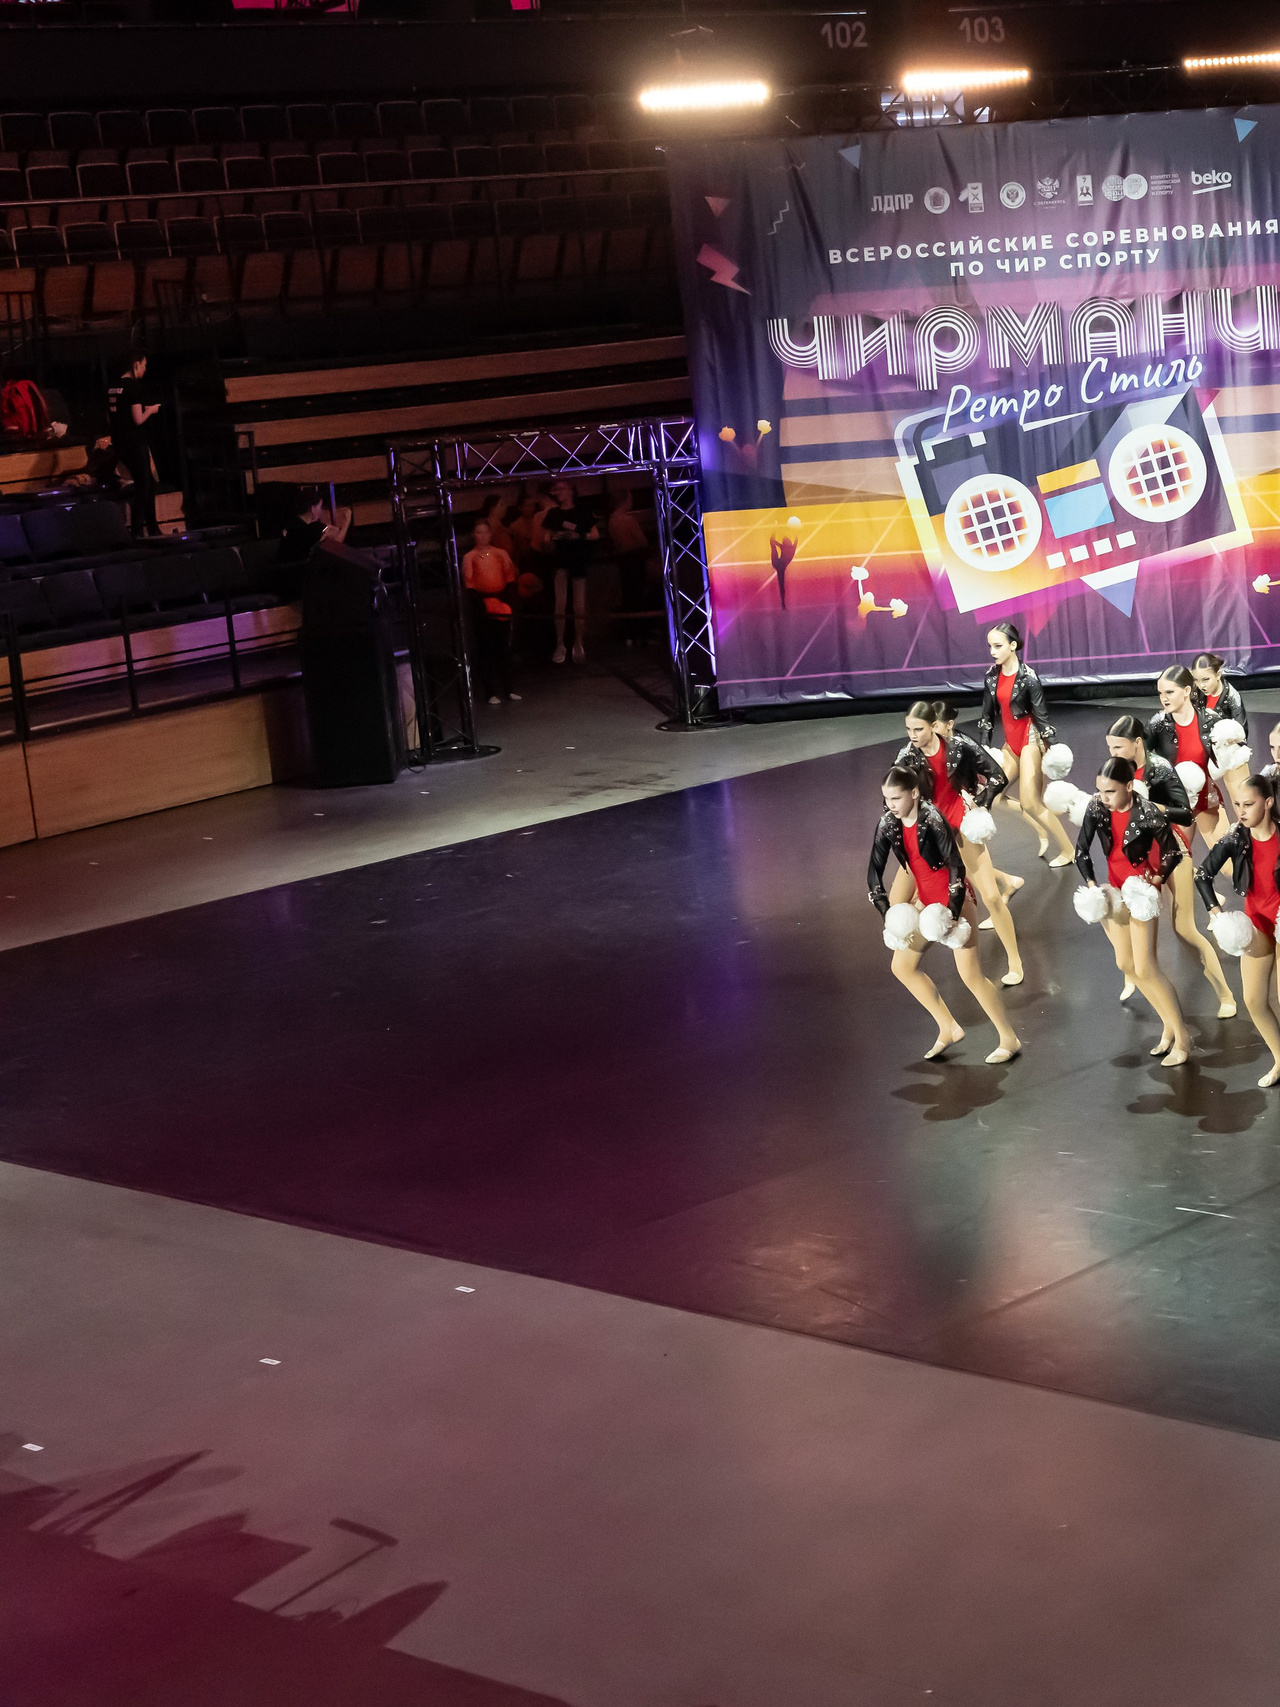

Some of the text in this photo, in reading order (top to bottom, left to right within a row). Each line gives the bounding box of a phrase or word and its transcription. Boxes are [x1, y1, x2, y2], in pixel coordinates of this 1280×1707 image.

[820, 20, 868, 49] 102
[958, 15, 1006, 44] 103
[1190, 169, 1233, 186] beko
[870, 193, 914, 214] ЛДПР
[827, 218, 1280, 265] ВСЕРОССИЙСКИЕ СОРЕВНОВАНИЯ
[949, 248, 1162, 278] ПО ЧИР СПОРТУ
[942, 353, 1204, 433] Ретро Стиль
